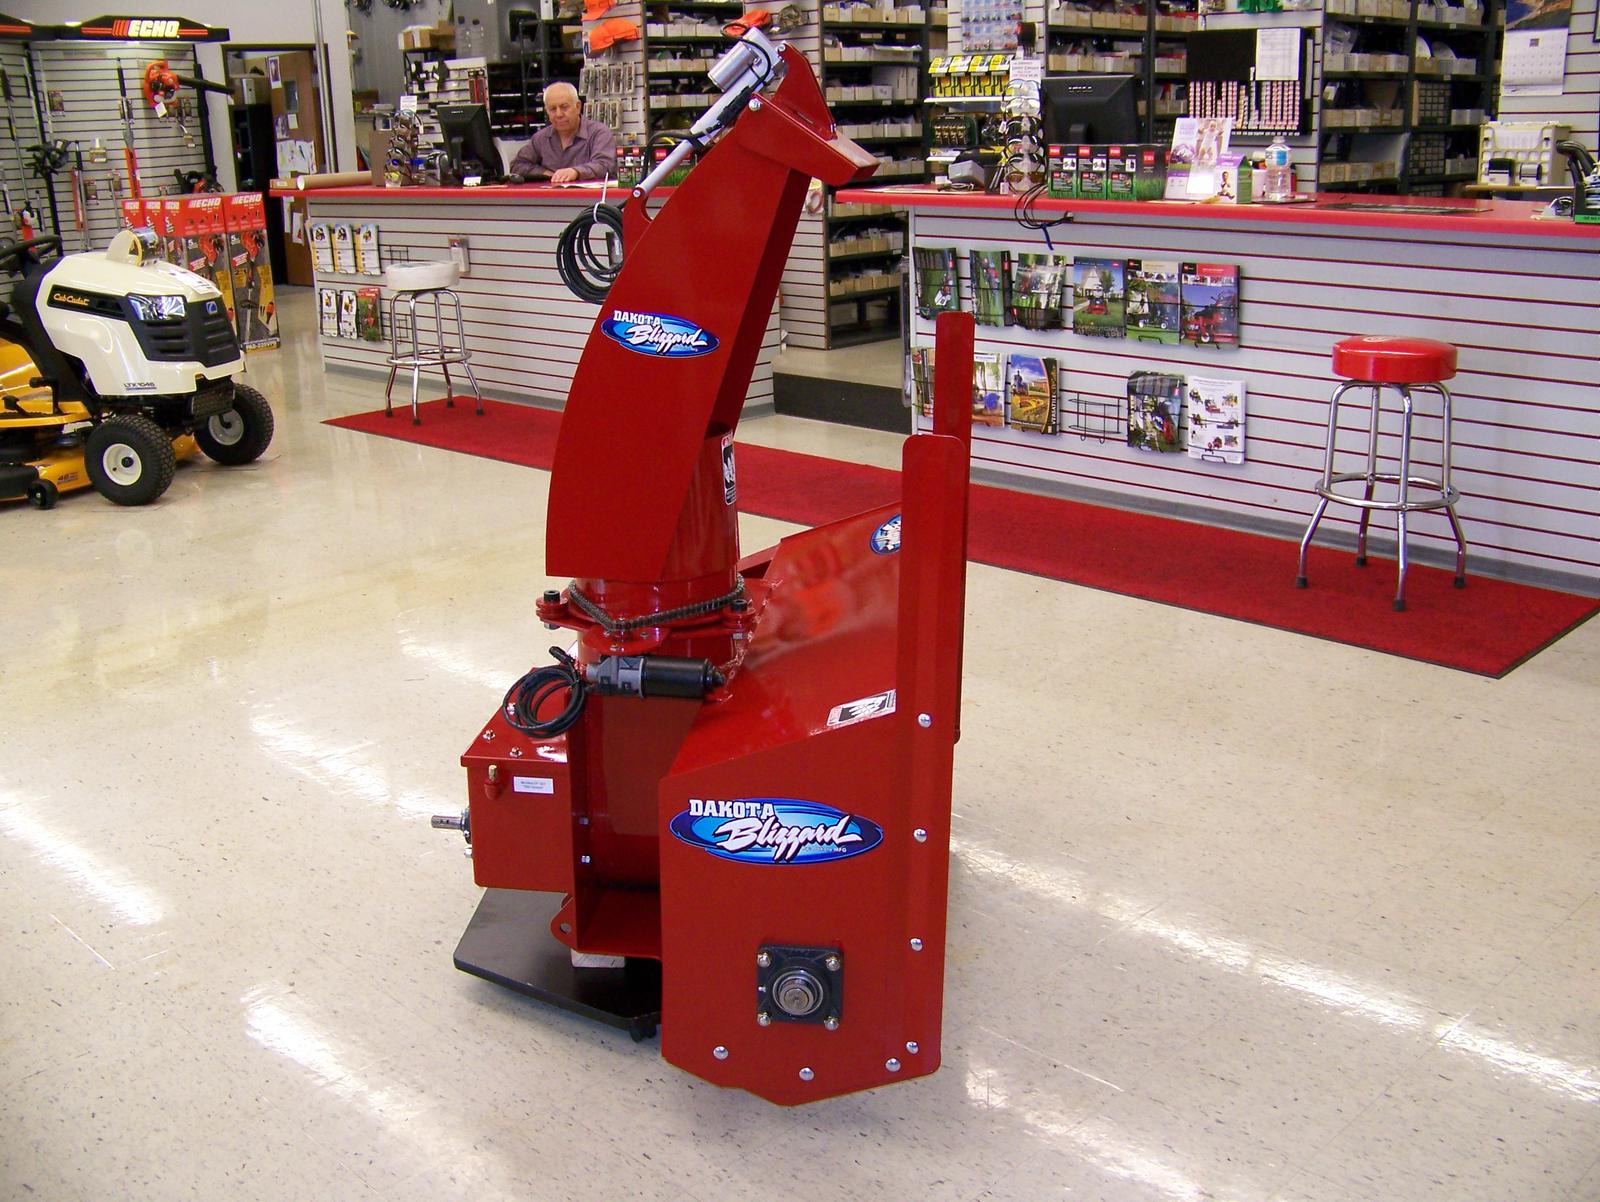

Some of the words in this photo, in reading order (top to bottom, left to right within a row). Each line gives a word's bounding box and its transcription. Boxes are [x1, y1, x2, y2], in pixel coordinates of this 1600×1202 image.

[128, 20, 180, 38] ECHO
[195, 198, 221, 208] ECHO
[237, 194, 262, 205] ECHO
[53, 293, 66, 302] Cub
[613, 310, 661, 326] DAKOTA
[625, 325, 708, 353] Blizzard
[689, 799, 775, 821] DAKOTA
[714, 815, 863, 861] Blizzard
